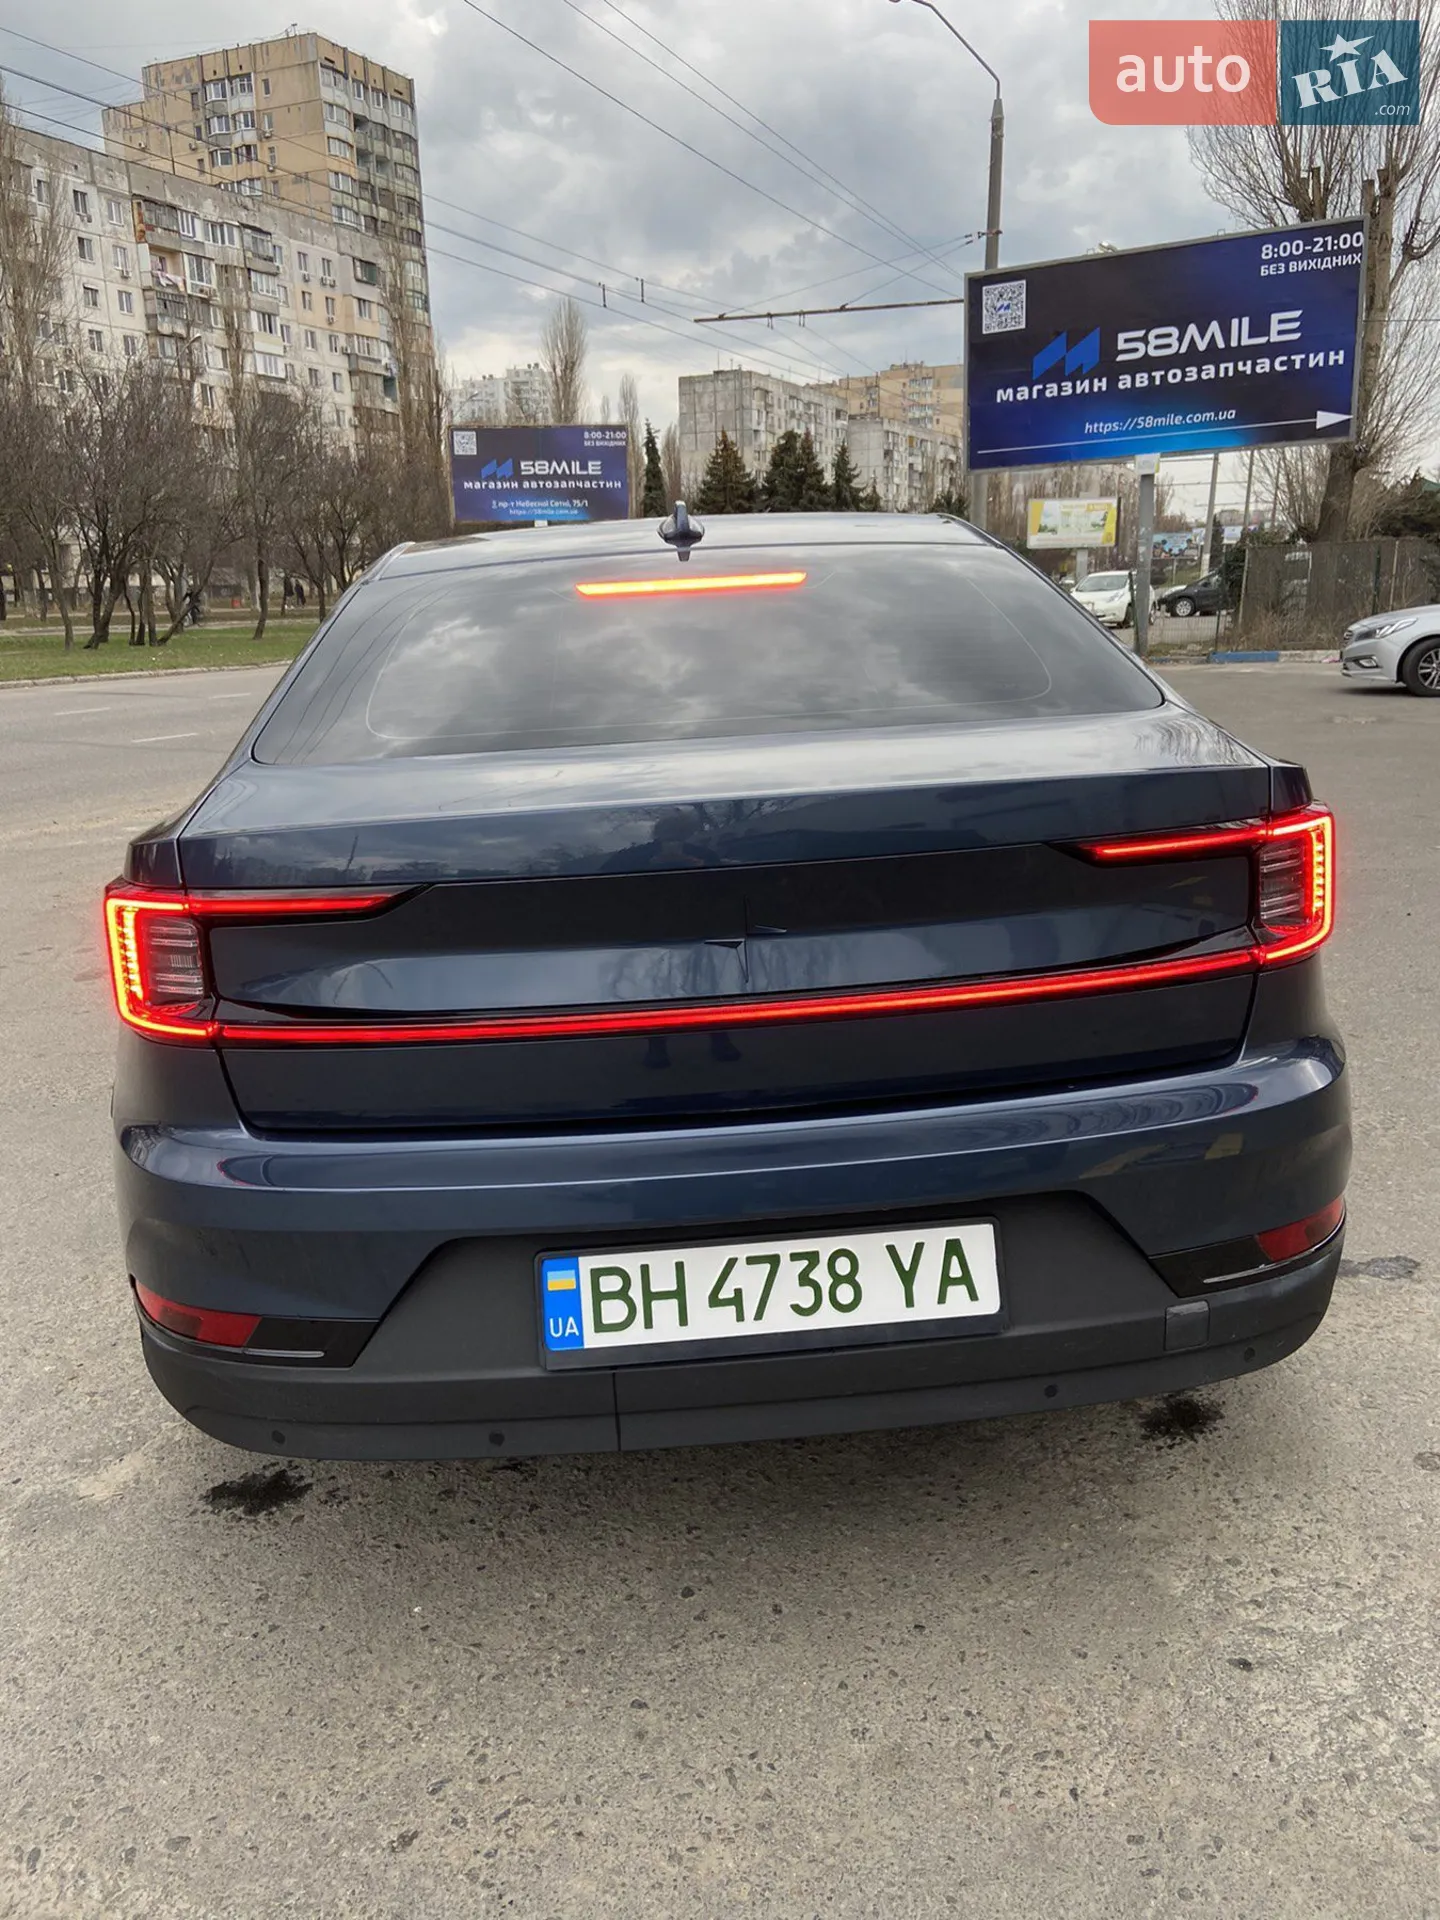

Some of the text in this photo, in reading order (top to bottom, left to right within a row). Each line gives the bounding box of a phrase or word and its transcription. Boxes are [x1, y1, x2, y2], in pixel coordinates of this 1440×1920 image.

[1260, 231, 1364, 260] 8:00-21:00
[1259, 252, 1362, 277] БЕЗ ВИХІДНИХ
[1115, 310, 1303, 362] 58MILE
[996, 350, 1345, 403] магазин автозапчастин
[1084, 409, 1236, 435] https://58mile.com.ua
[583, 431, 627, 440] 8:00-21:00
[520, 460, 603, 475] 58MILE
[463, 479, 622, 490] магазин автозапчастин
[590, 1238, 980, 1335] BH 4738 YA
[549, 1317, 579, 1338] UA
